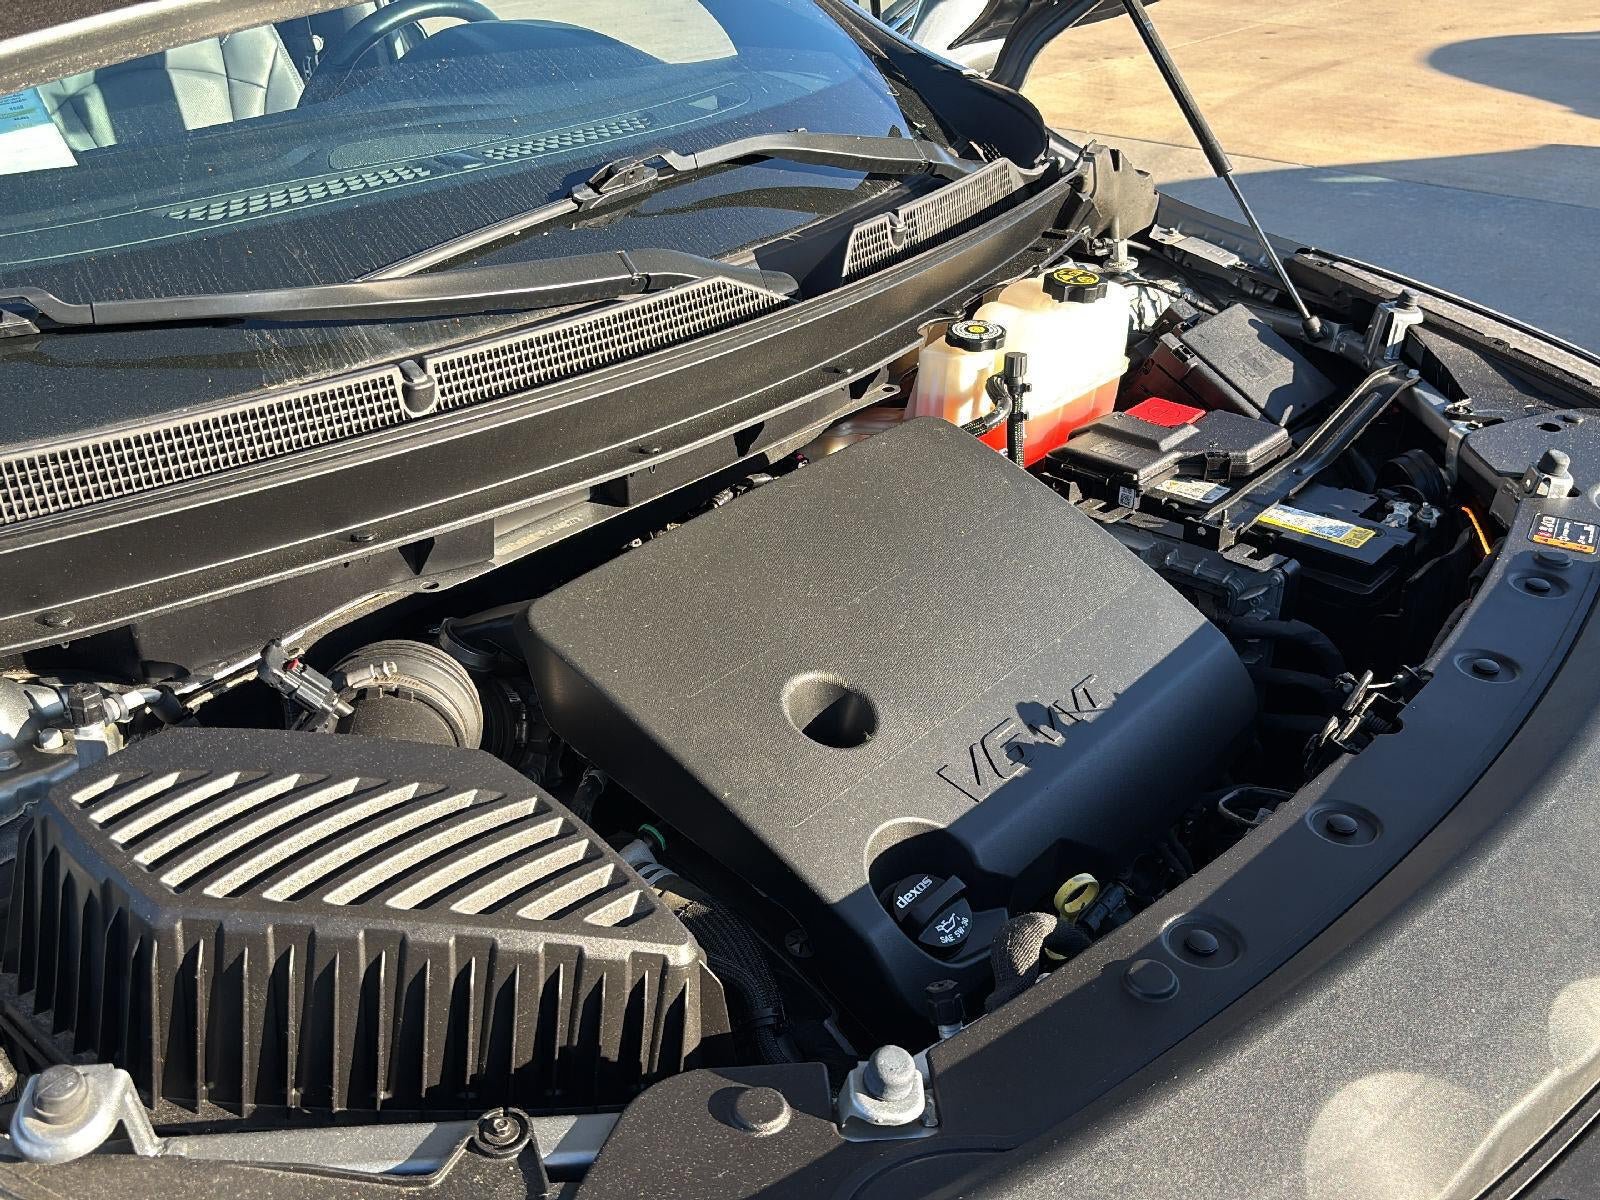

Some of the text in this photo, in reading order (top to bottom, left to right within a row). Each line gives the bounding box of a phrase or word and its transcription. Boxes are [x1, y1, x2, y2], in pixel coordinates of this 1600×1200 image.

[935, 717, 1036, 803] V6
[896, 875, 933, 909] dexos
[939, 933, 956, 944] SAE
